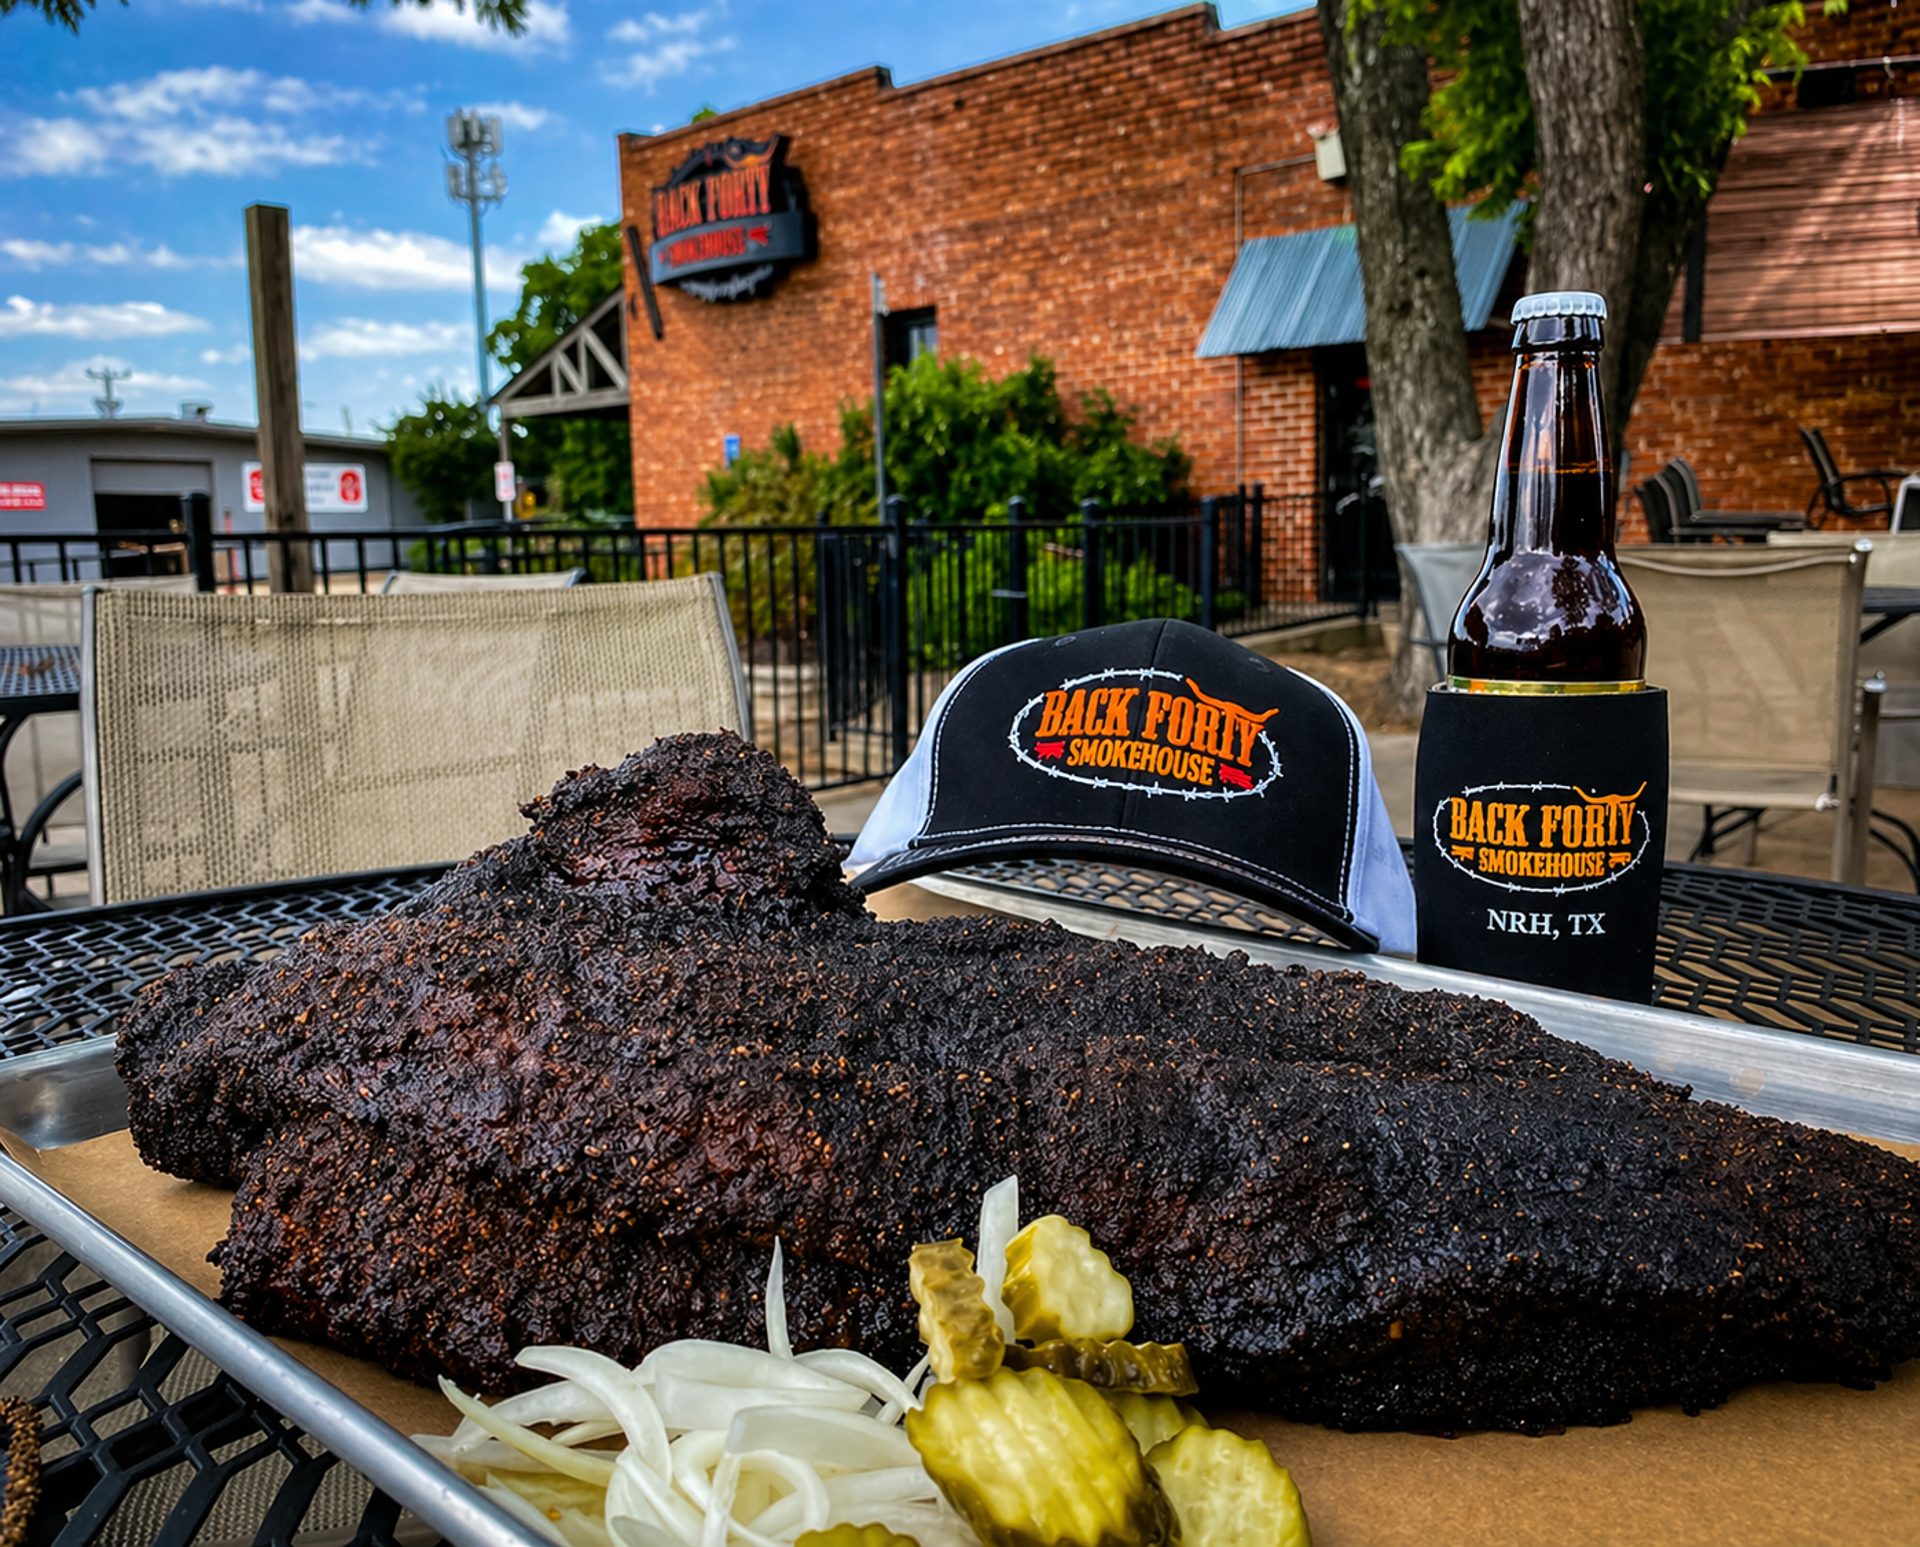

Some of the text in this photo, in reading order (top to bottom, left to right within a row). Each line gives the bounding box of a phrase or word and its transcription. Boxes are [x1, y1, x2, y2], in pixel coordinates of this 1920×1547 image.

[657, 166, 770, 237] BACK FORTY
[1034, 688, 1264, 767] BACK FORTY
[1066, 738, 1216, 786] SMOKEHOUSE
[1449, 797, 1637, 849] BACK FORTY
[1477, 847, 1606, 878] SMOKEHOUSE
[1486, 908, 1606, 940] NRH, TX
